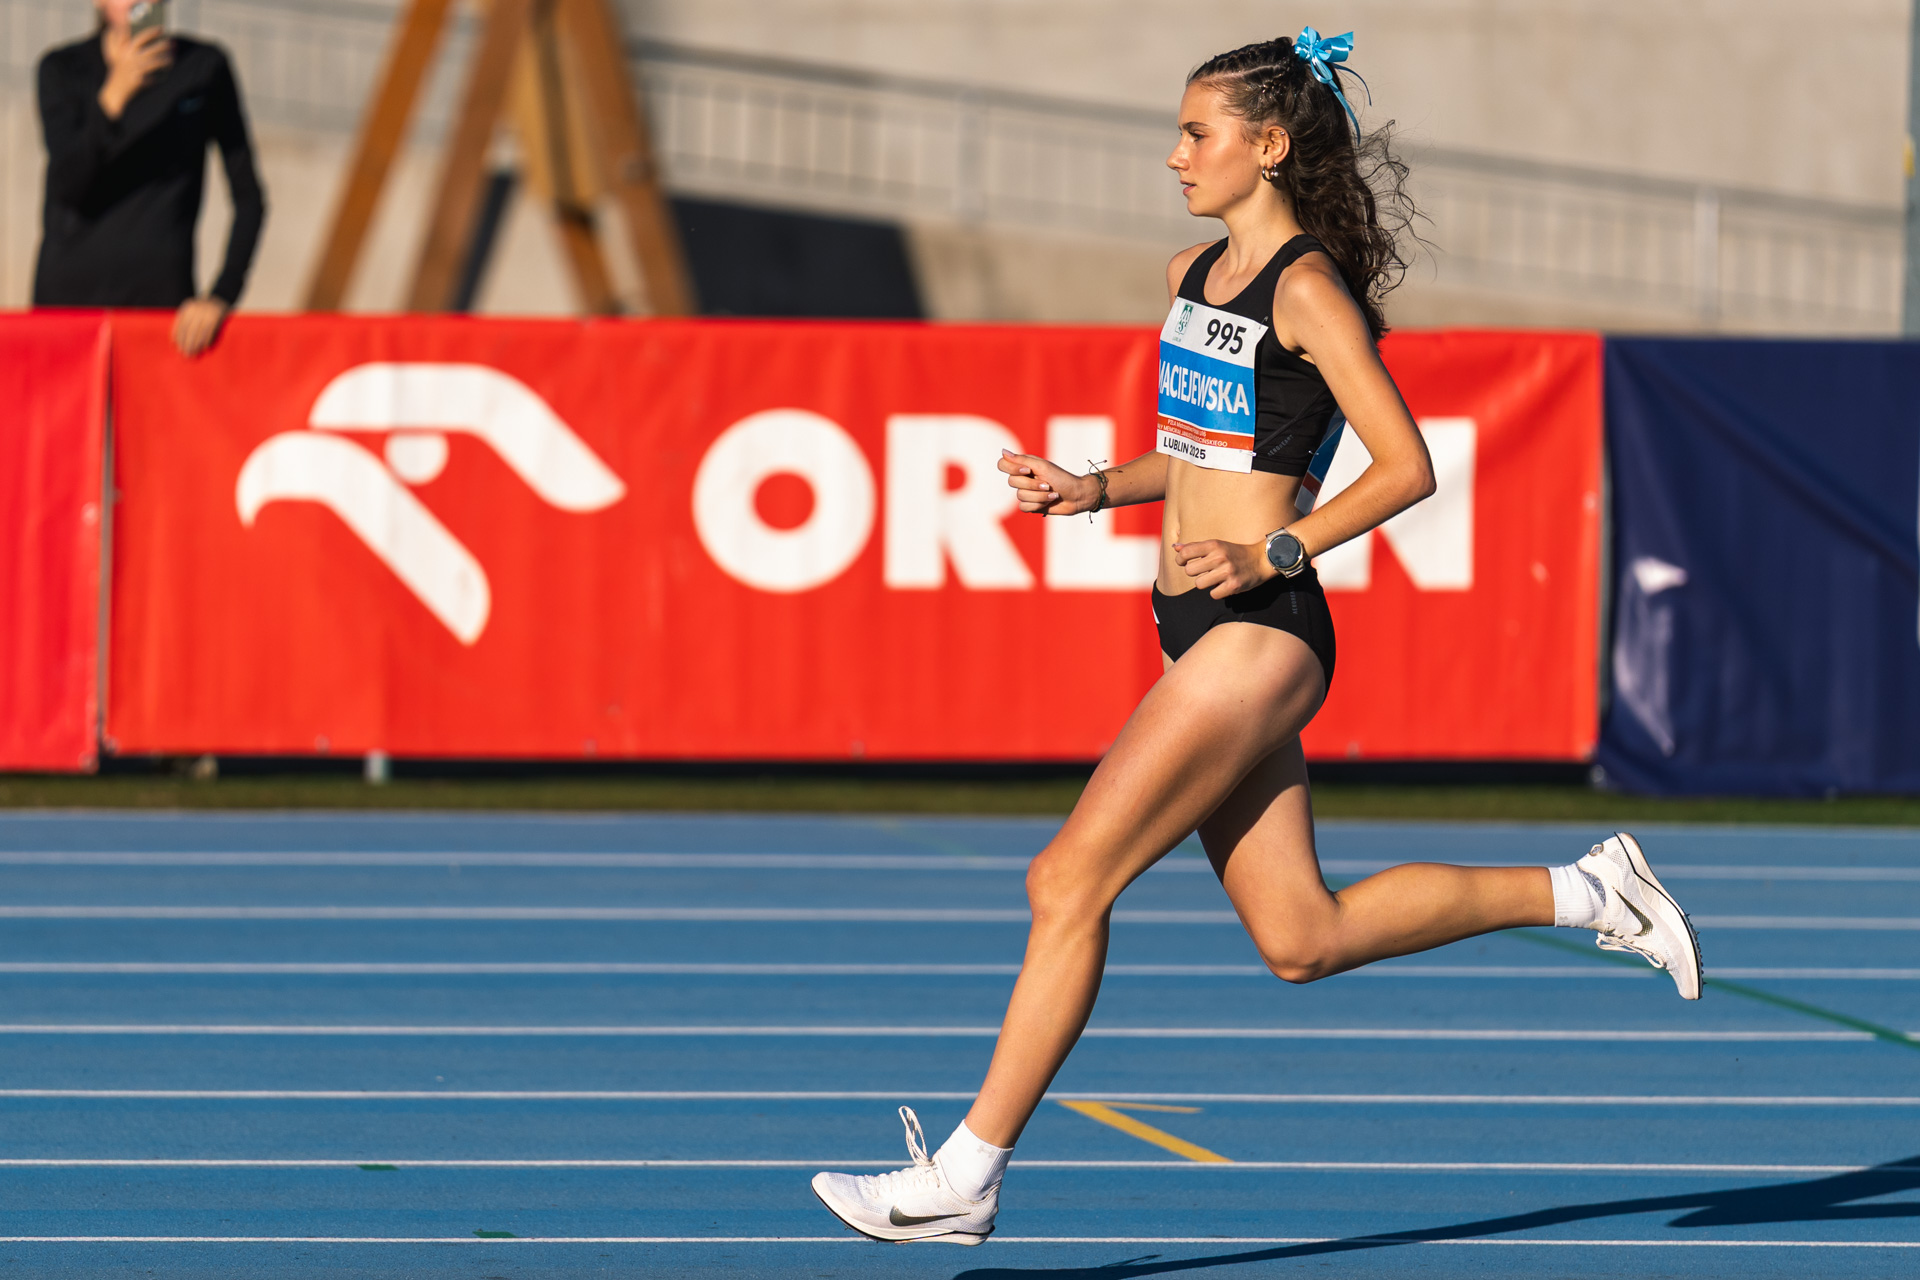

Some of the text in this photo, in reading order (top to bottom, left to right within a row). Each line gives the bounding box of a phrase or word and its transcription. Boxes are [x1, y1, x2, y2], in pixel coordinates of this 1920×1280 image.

[1204, 318, 1247, 355] 995
[1163, 436, 1206, 460] LUBLIN 2025
[692, 409, 1475, 592] ORLN
